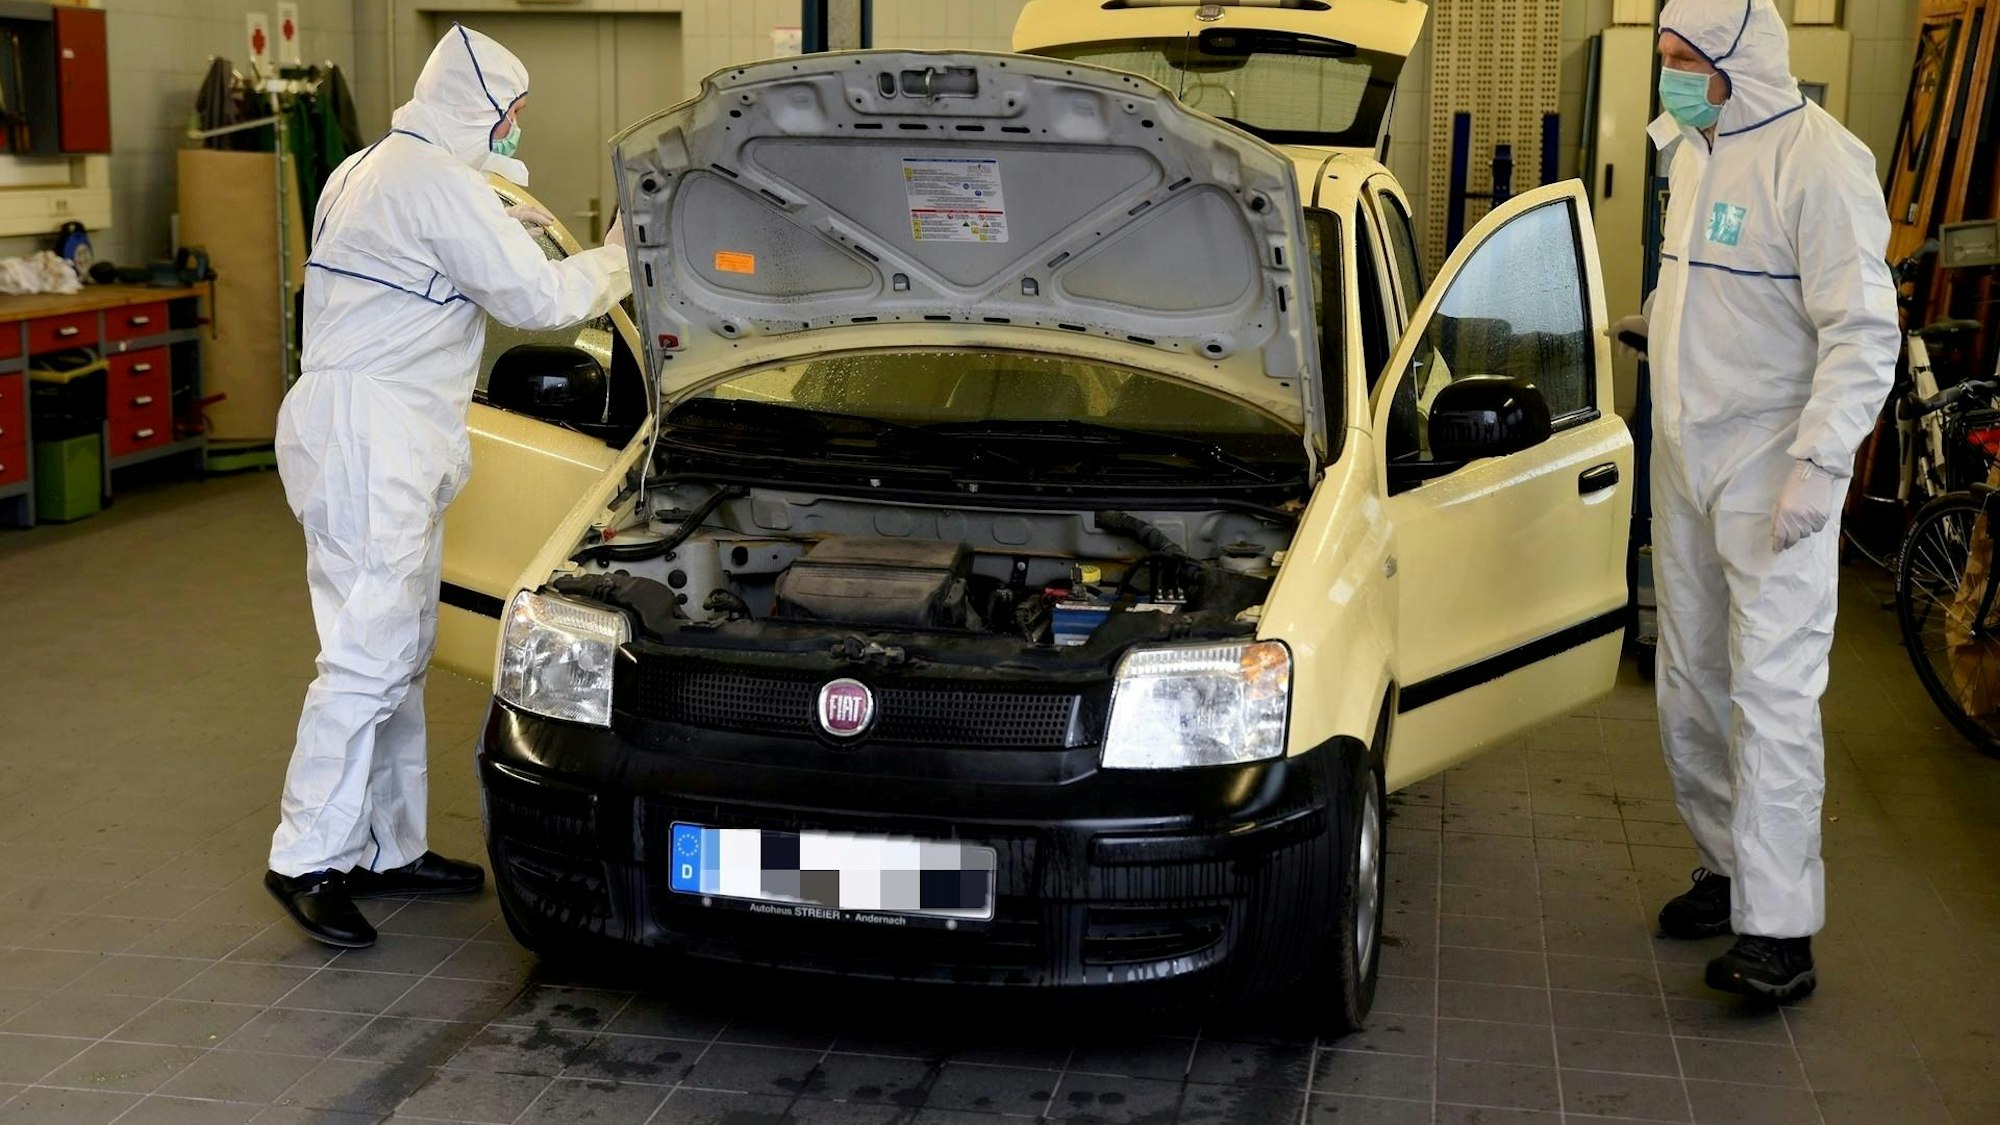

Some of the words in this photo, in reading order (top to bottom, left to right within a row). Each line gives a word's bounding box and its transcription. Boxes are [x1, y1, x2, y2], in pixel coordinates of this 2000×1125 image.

[829, 694, 862, 722] FIAT
[681, 864, 693, 879] D
[749, 903, 792, 916] Autohaus
[794, 906, 841, 920] STREIER
[855, 912, 906, 926] Andernach
